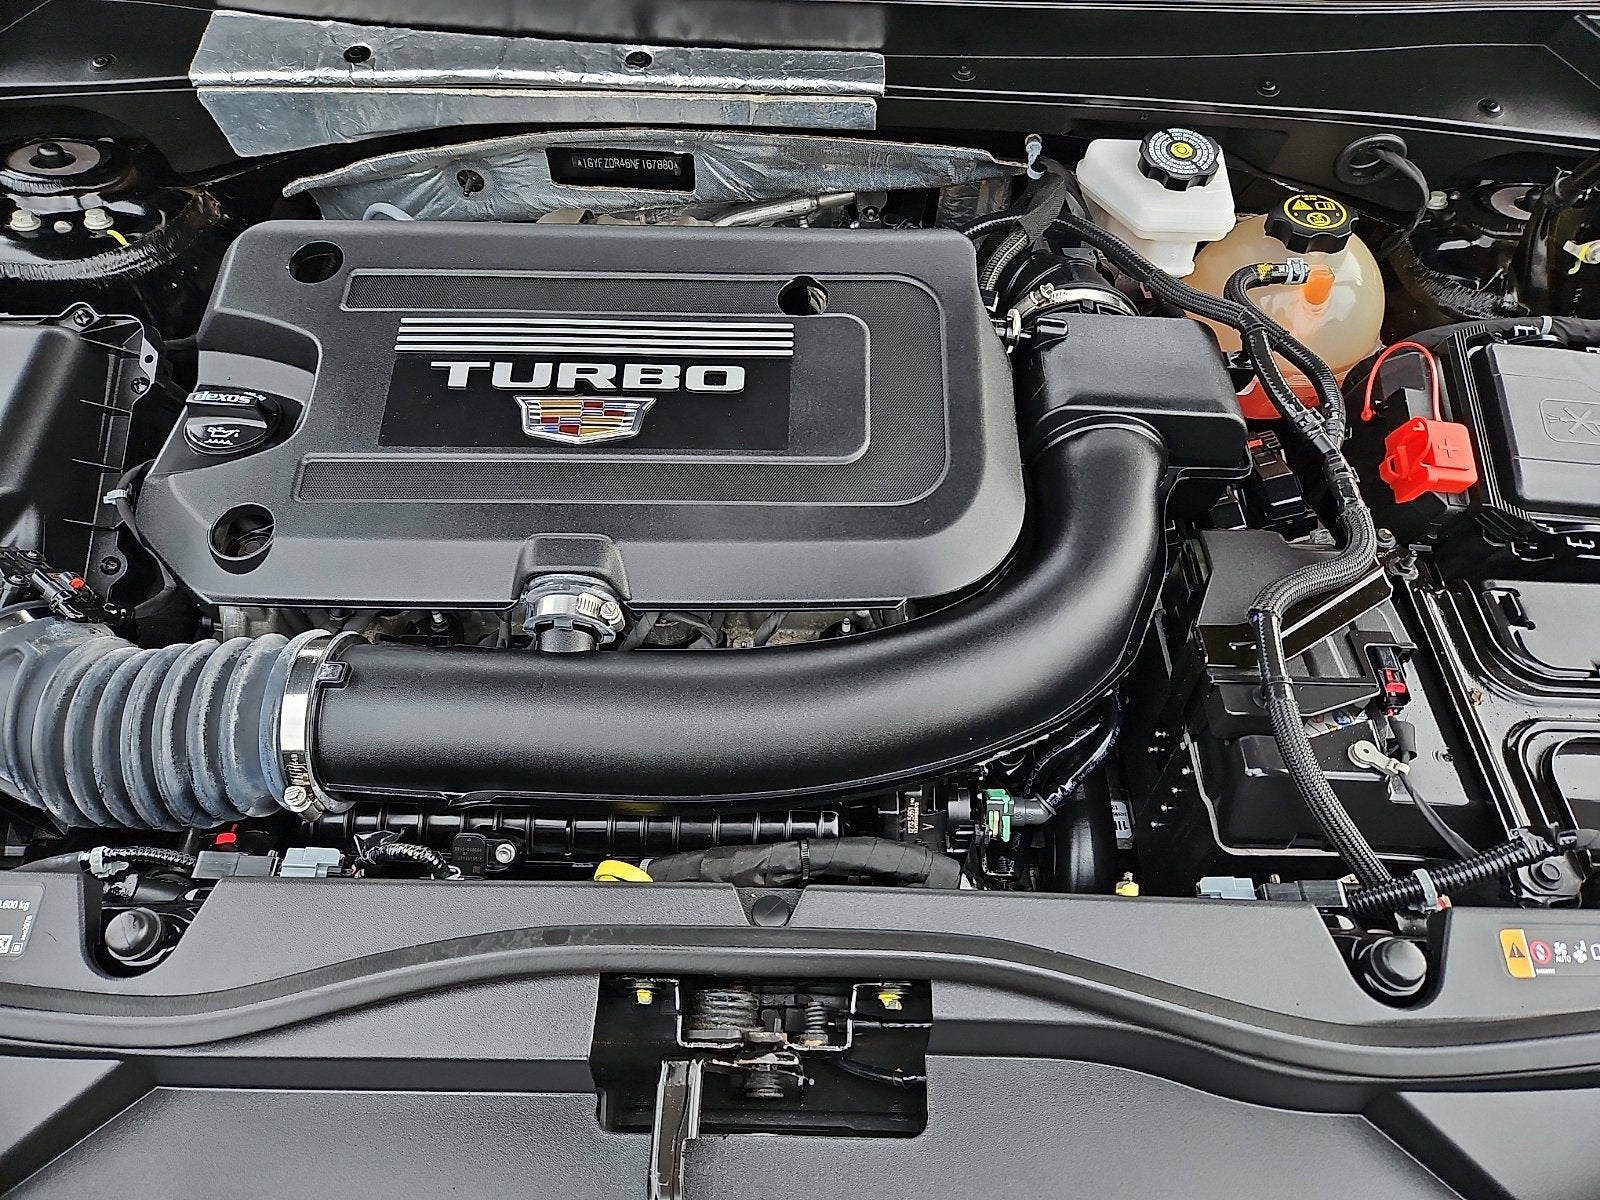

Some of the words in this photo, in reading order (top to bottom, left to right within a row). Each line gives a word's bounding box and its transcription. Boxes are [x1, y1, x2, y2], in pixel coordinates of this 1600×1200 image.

[430, 361, 746, 392] TURBO
[194, 390, 254, 404] dexos
[19, 900, 31, 912] kg
